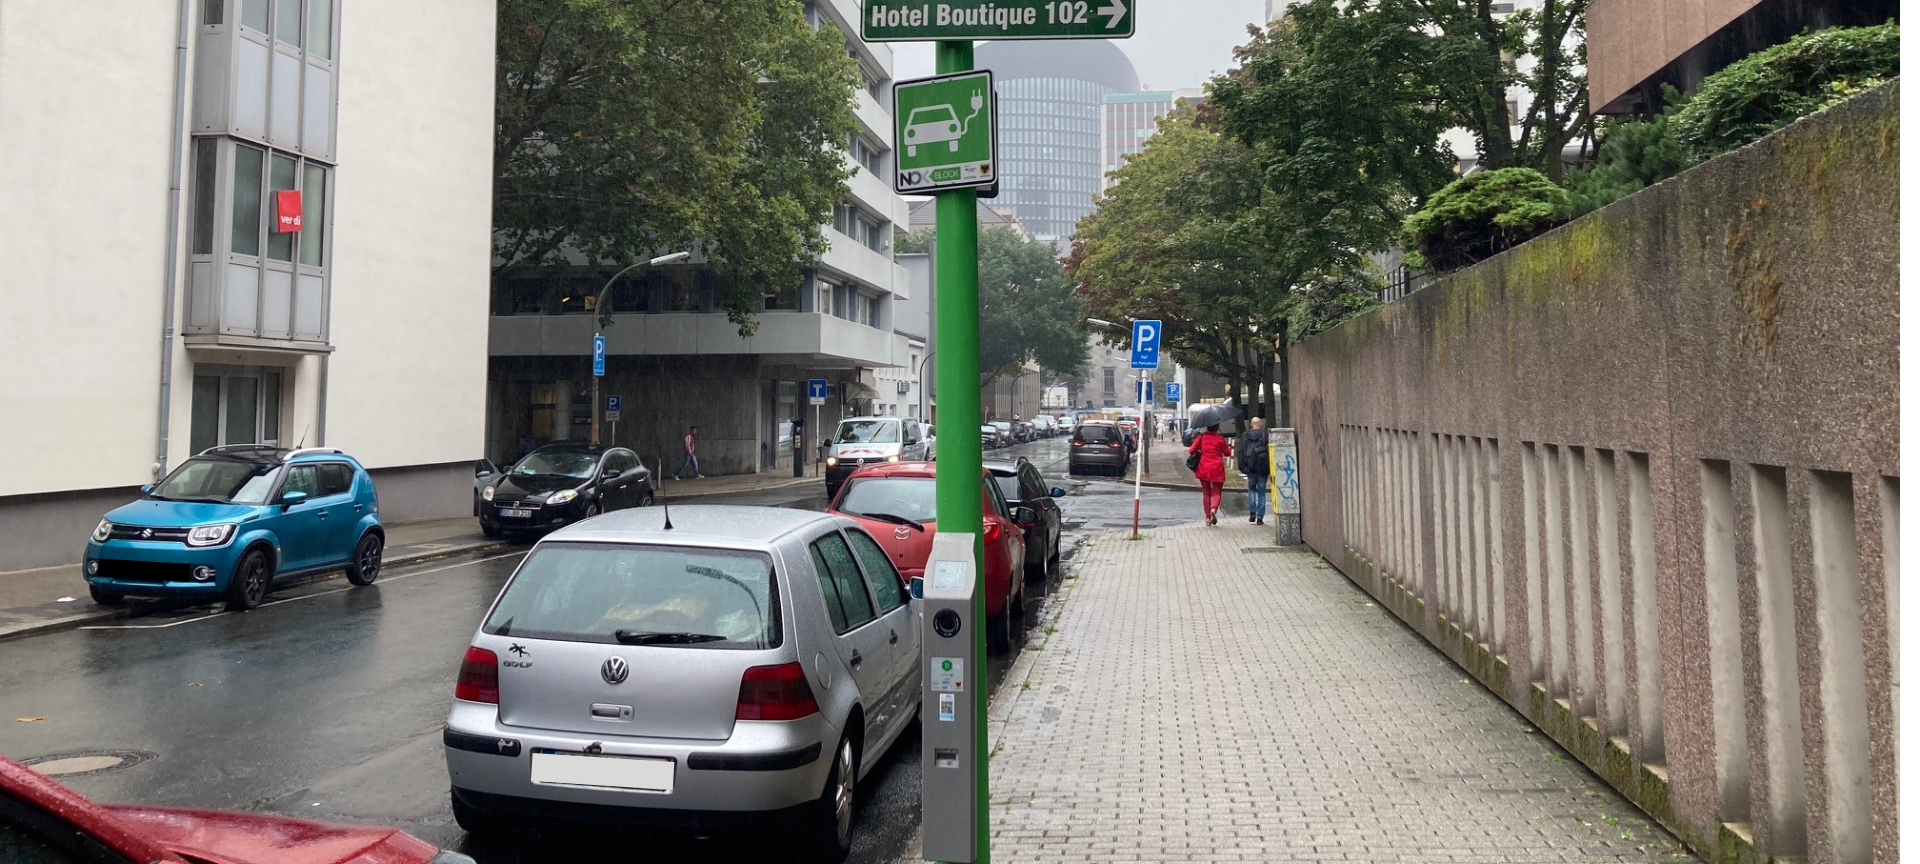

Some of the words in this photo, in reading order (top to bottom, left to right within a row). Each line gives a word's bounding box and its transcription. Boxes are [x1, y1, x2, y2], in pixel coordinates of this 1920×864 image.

[871, 5, 929, 27] Hotel
[936, 3, 1036, 30] Boutique
[1045, 1, 1088, 25] 102
[1137, 325, 1155, 352] P
[596, 340, 603, 362] P
[609, 397, 617, 409] P
[503, 660, 533, 669] GOLF
